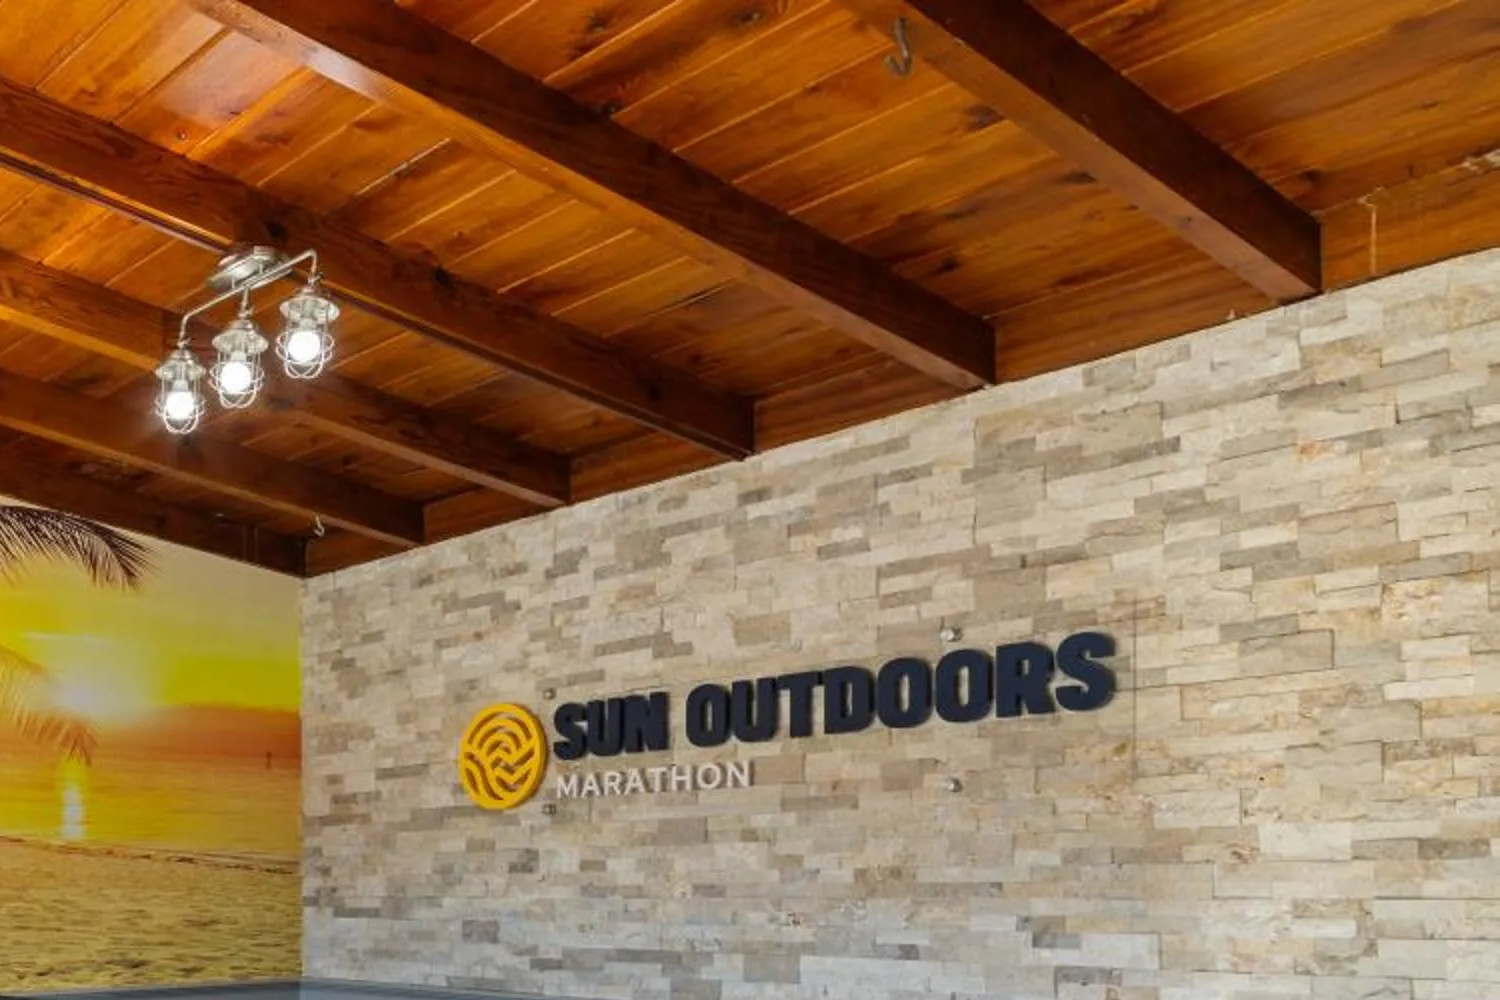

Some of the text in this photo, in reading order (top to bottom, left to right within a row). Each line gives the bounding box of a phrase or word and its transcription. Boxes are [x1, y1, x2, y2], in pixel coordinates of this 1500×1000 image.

[553, 632, 1117, 761] SUN OUTDOORS
[556, 760, 754, 799] MARATHON
